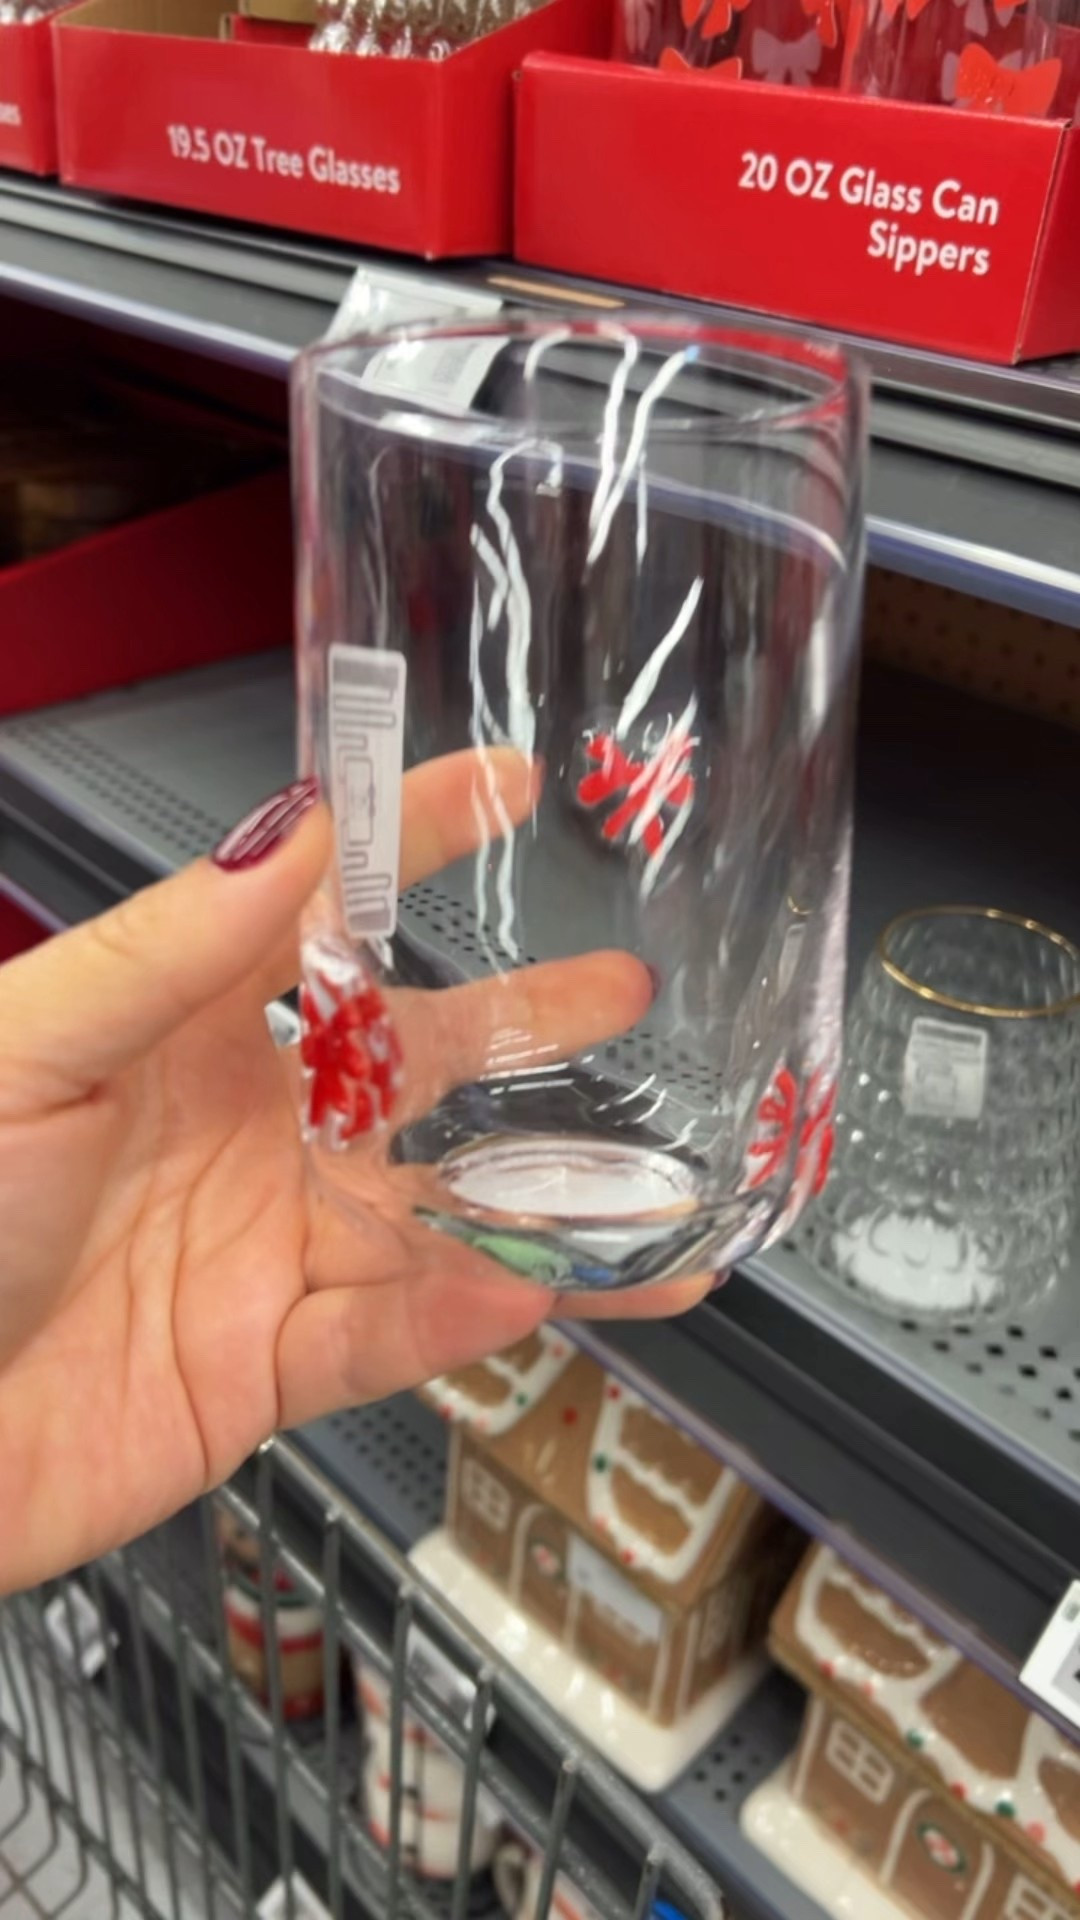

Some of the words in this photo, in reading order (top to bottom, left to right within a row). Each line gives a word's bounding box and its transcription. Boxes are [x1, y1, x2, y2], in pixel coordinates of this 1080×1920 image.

[167, 124, 211, 162] 19.5
[213, 131, 249, 169] OZ
[252, 136, 304, 178] Tree
[307, 145, 401, 194] Glasses
[738, 151, 779, 192] 20
[785, 158, 834, 201] OZ
[839, 165, 923, 214] Glass
[932, 179, 999, 226] Can
[866, 219, 990, 276] Sippers
